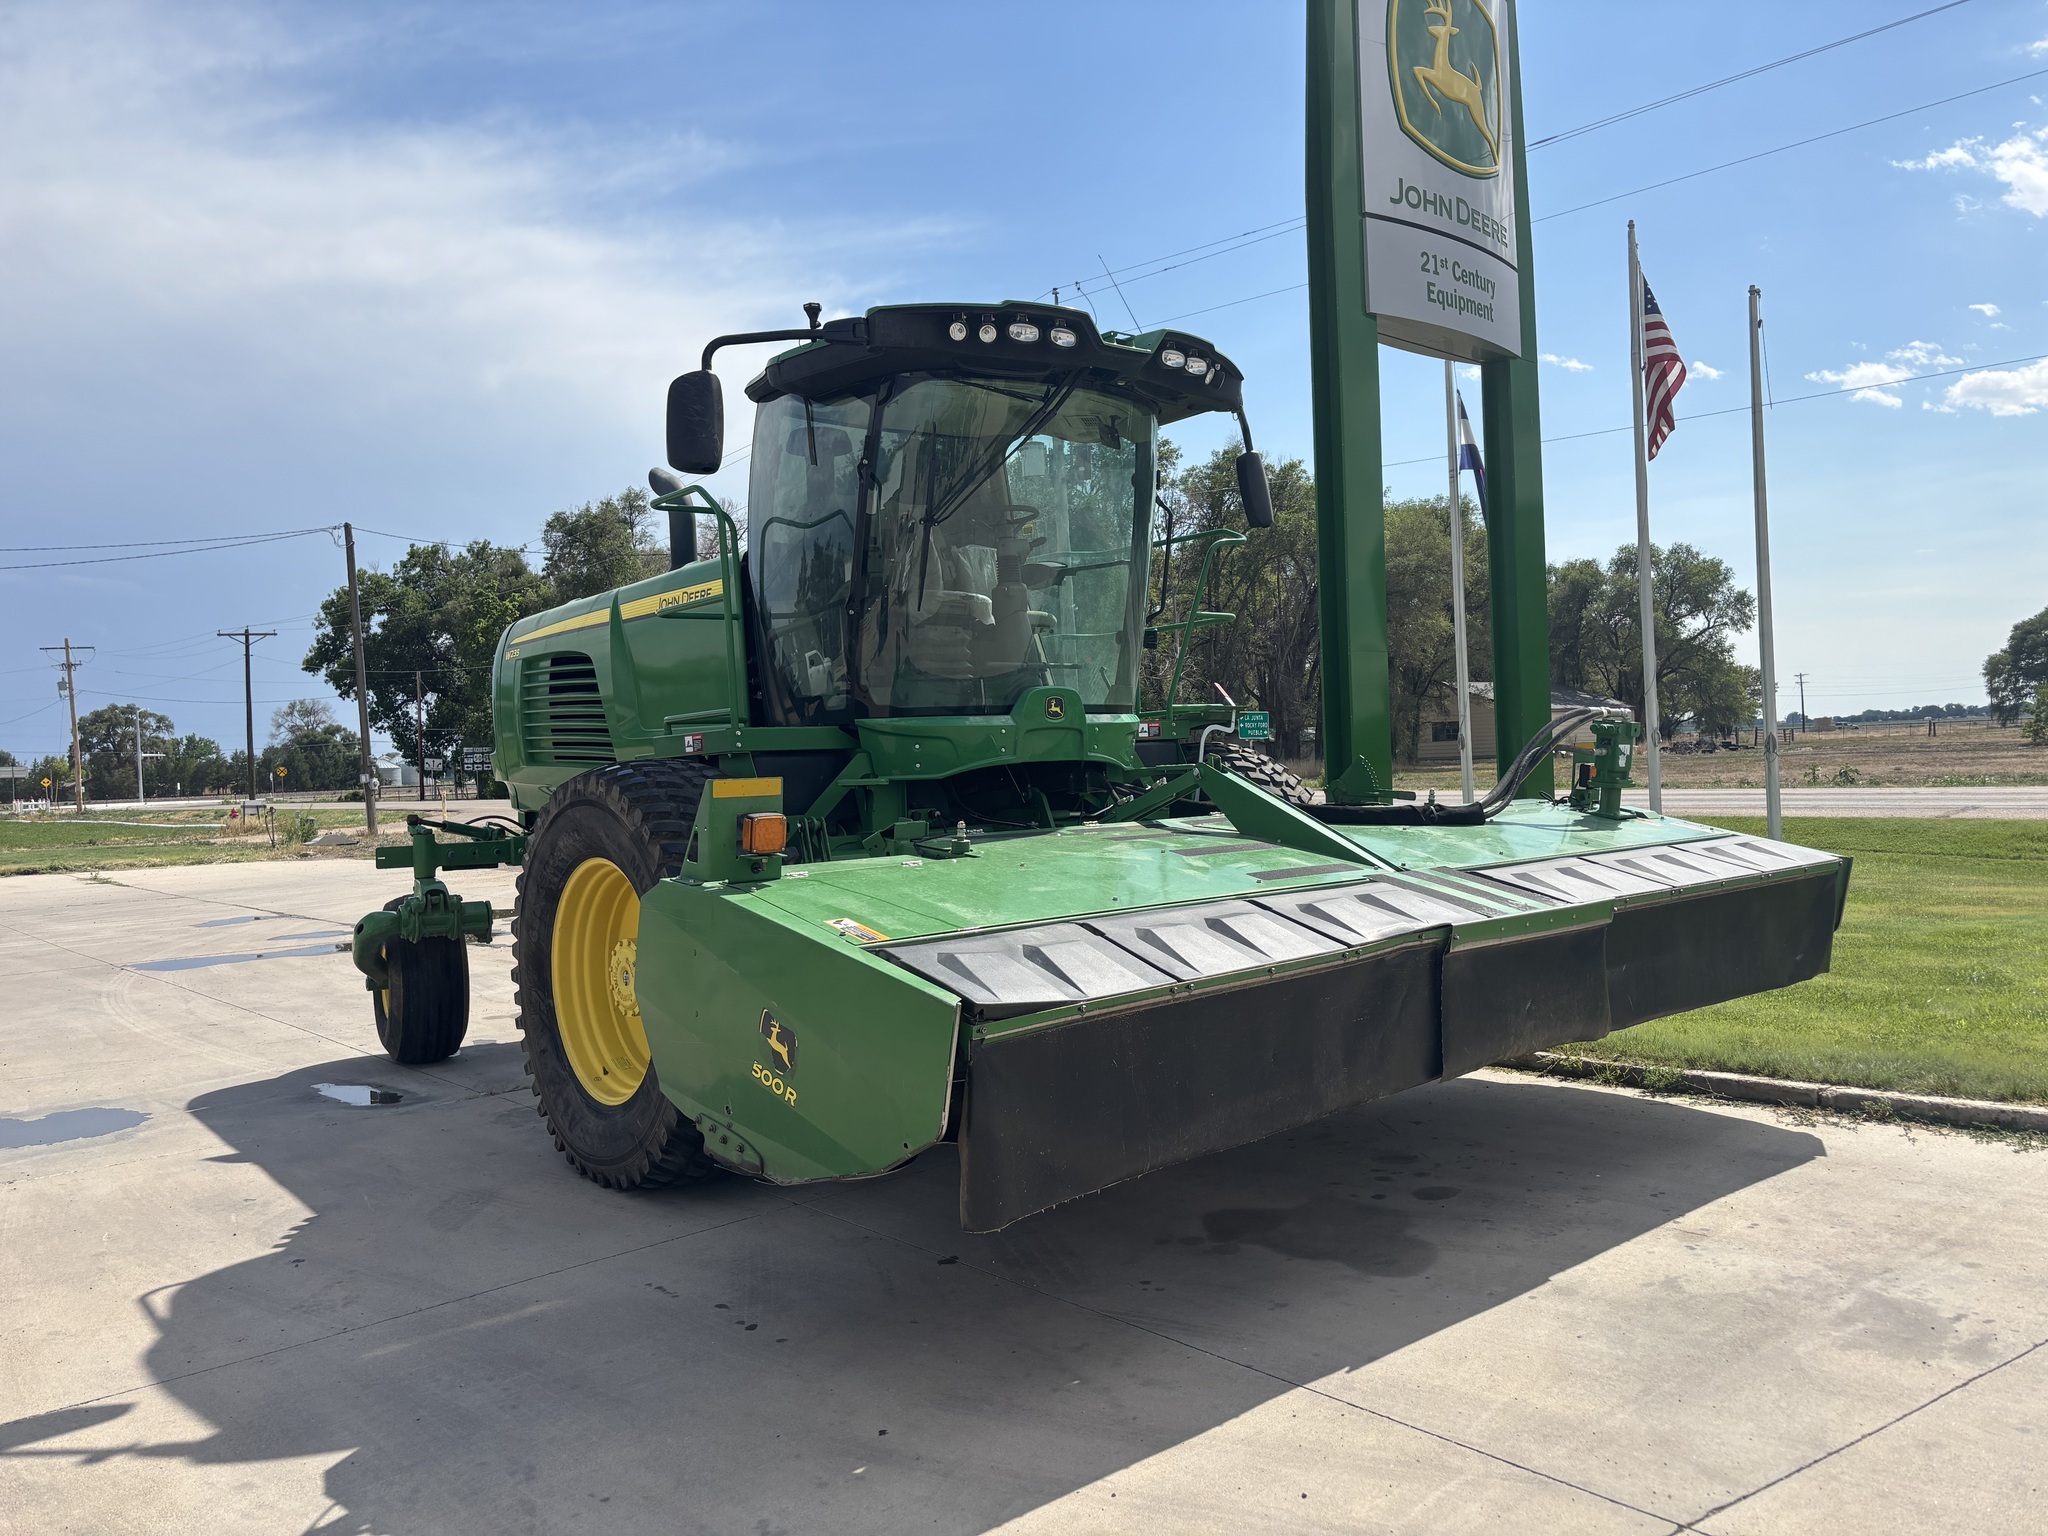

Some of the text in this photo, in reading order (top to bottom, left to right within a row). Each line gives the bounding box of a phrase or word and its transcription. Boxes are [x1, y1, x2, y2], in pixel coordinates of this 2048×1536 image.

[1389, 177, 1508, 248] JOHN DEERE
[1420, 251, 1496, 300] 21st Century
[1426, 281, 1494, 322] Equipment
[655, 595, 680, 612] JOHN
[751, 1060, 798, 1107] 500R
